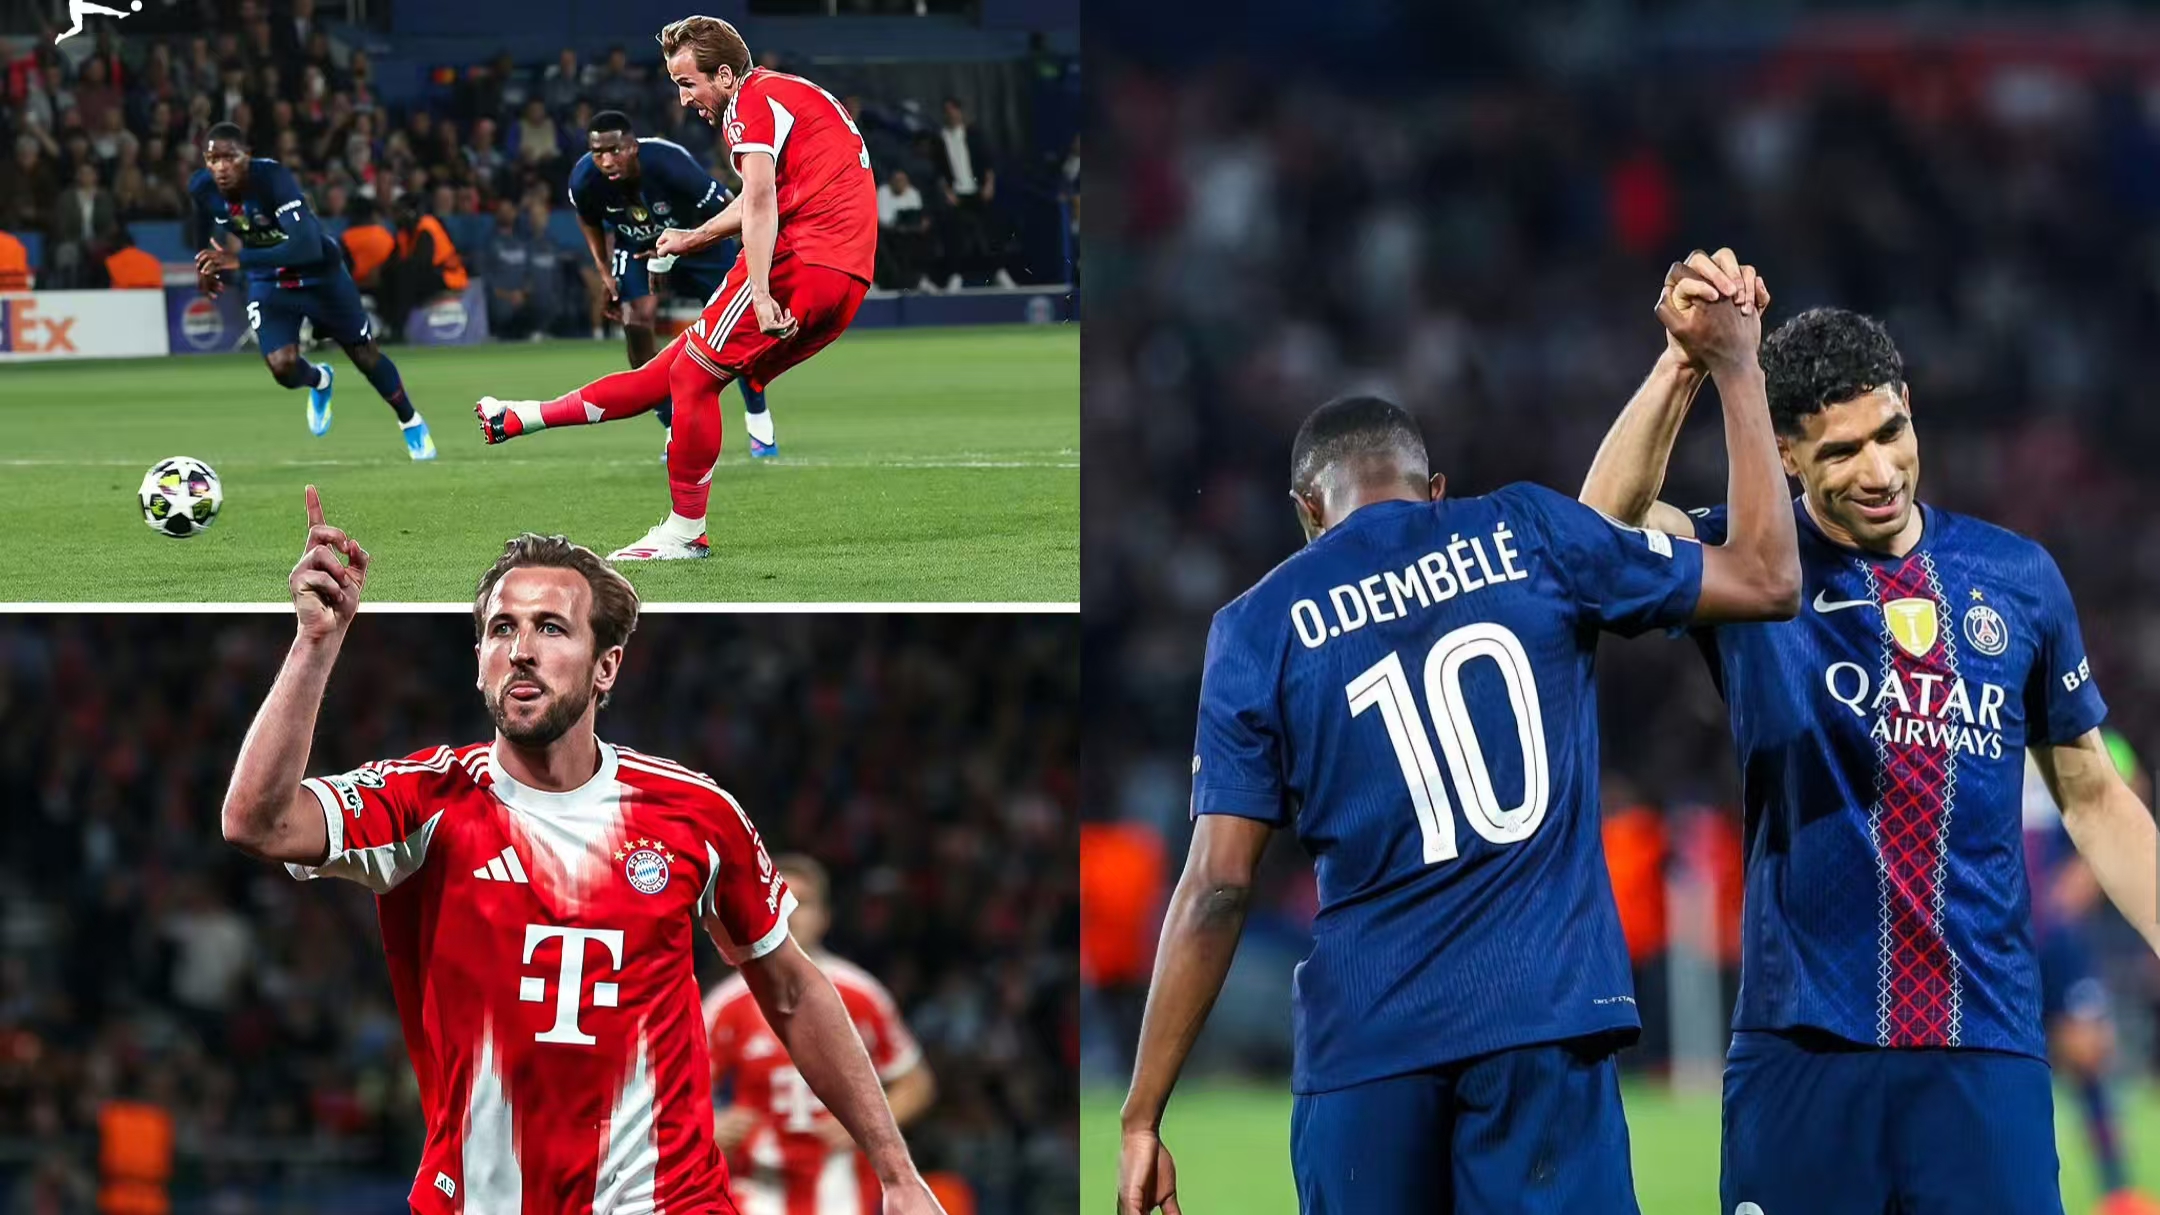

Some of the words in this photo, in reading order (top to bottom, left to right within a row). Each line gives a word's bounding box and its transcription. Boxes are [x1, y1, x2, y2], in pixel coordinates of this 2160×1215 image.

[1290, 521, 1528, 649] O.DEMBÉLÉ
[1345, 622, 1550, 865] 10
[1825, 661, 2005, 730] QATAR
[1870, 715, 2003, 760] AIRWAYS
[519, 923, 625, 1046] T
